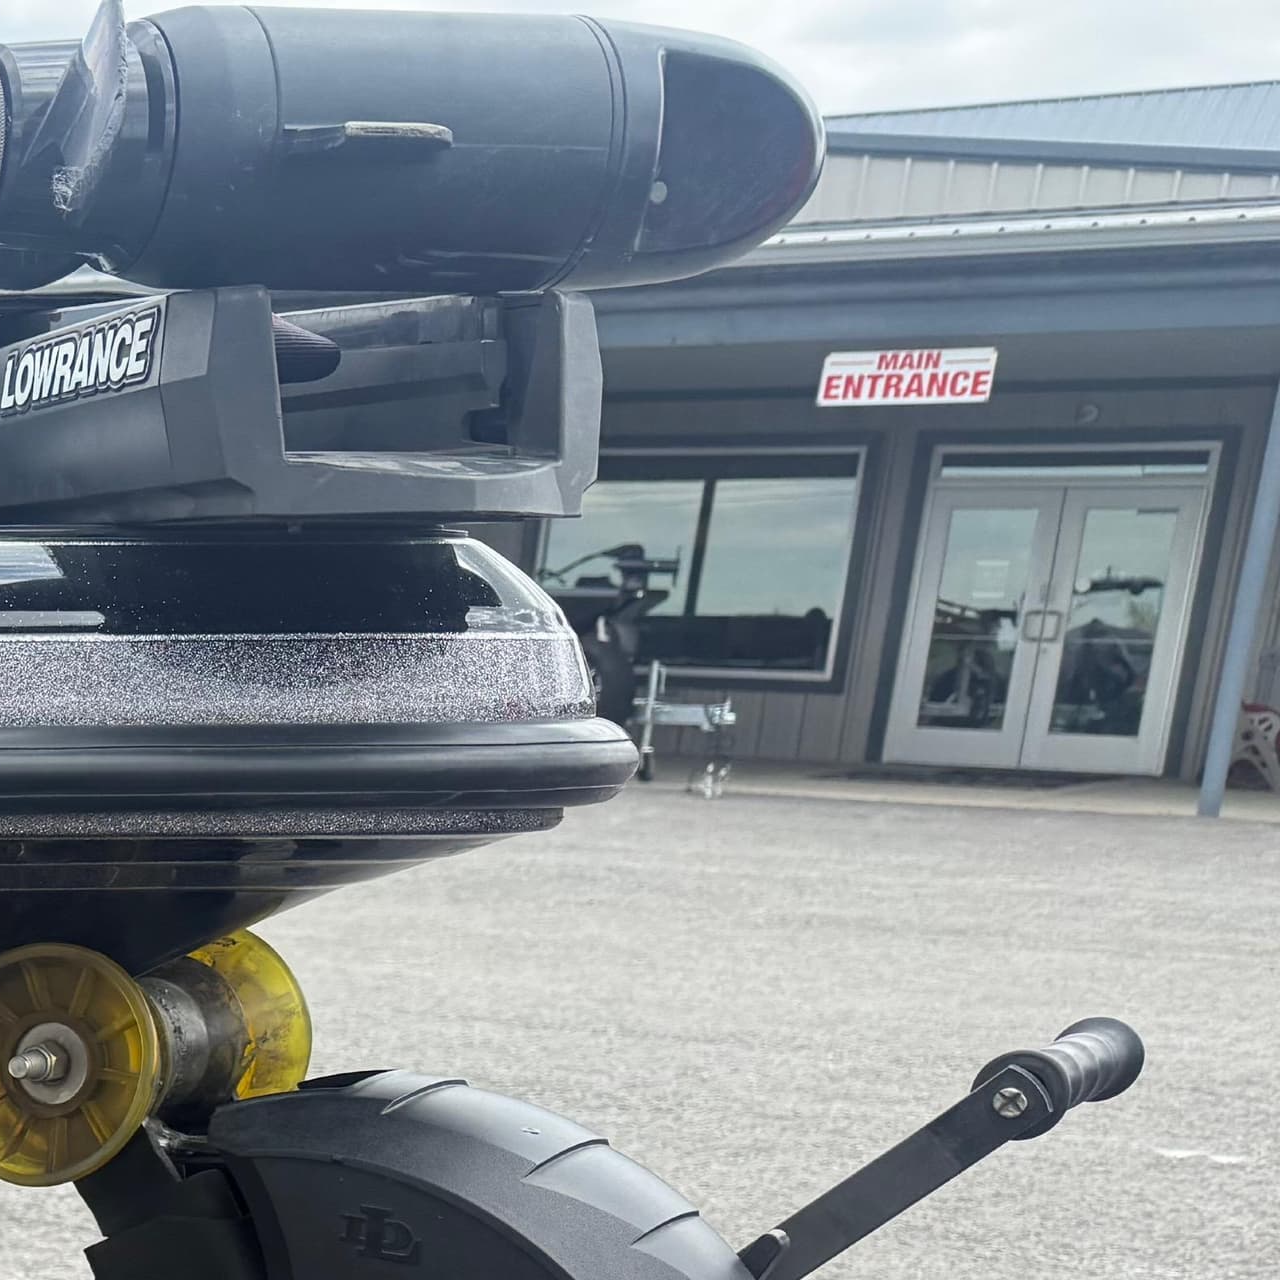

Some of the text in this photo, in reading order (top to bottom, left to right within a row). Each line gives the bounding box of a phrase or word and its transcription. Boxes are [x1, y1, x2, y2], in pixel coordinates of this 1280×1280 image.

[0, 315, 155, 411] LOWRANCE
[876, 350, 942, 371] MAIN
[822, 370, 991, 400] ENTRANCE
